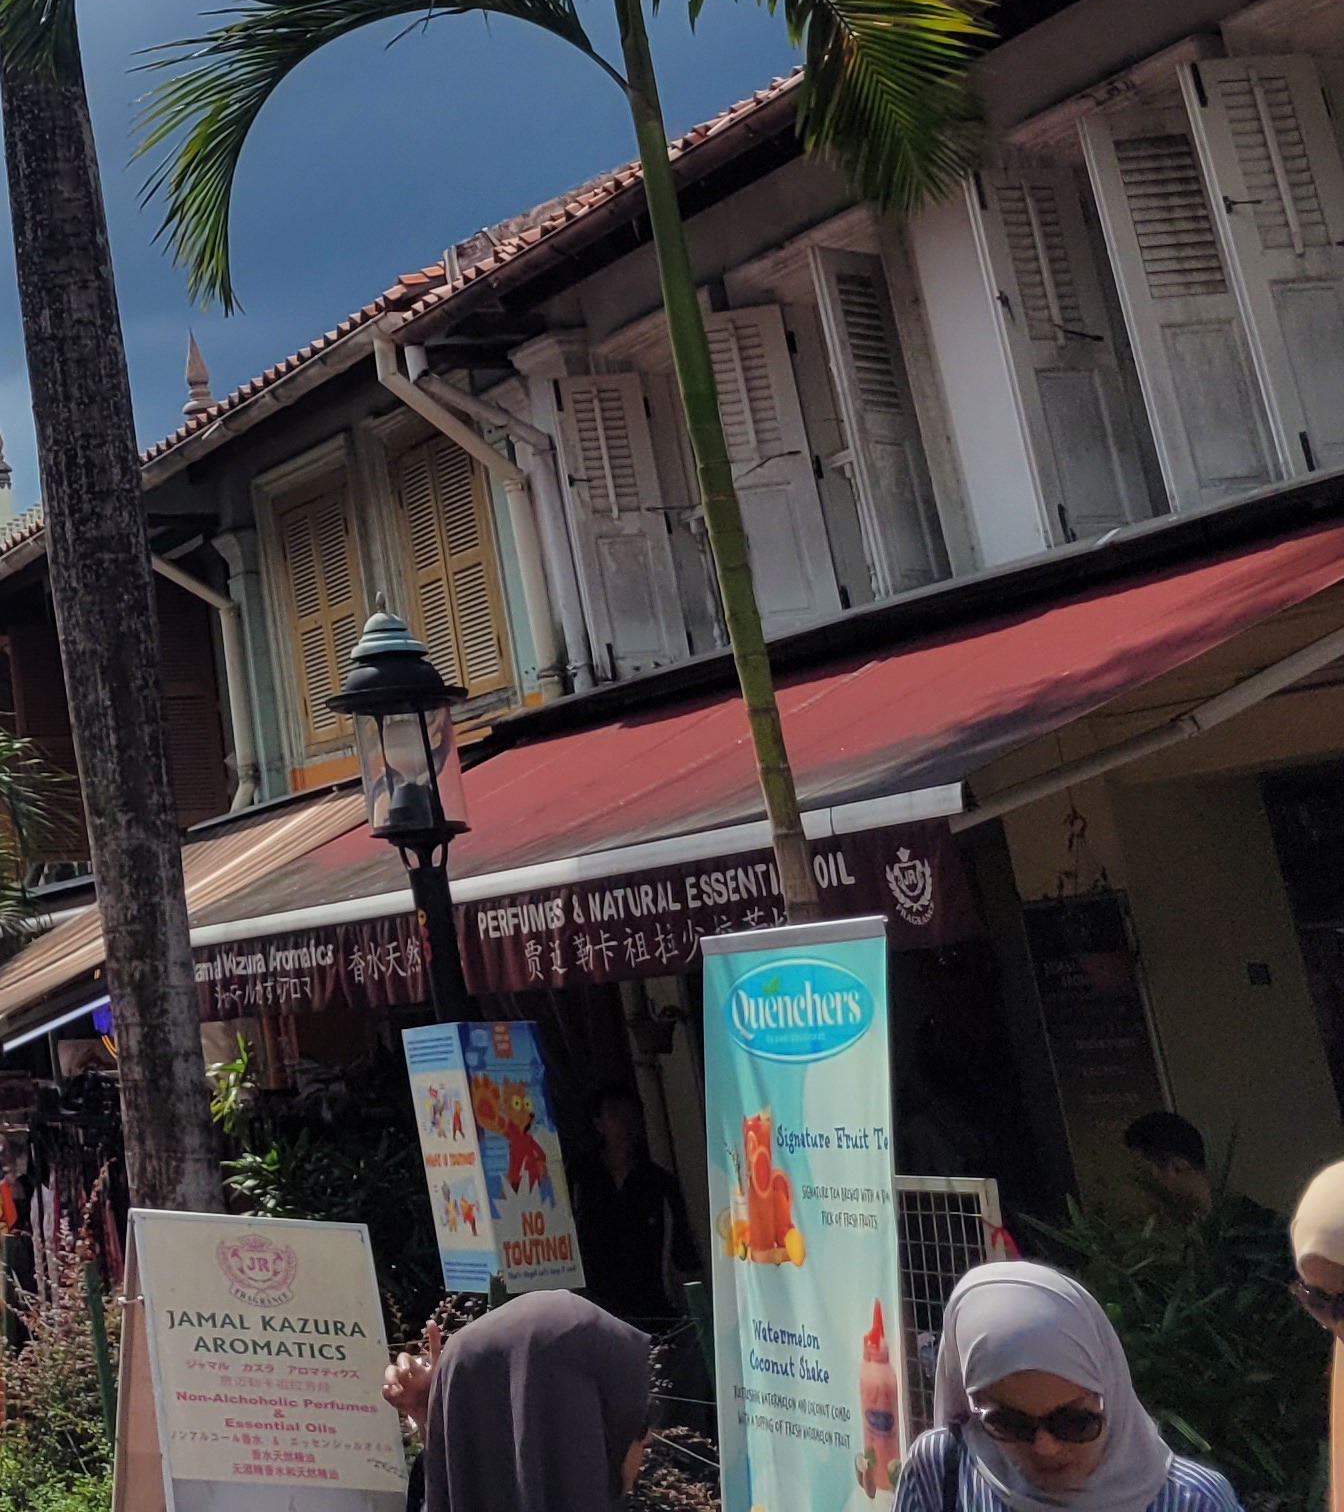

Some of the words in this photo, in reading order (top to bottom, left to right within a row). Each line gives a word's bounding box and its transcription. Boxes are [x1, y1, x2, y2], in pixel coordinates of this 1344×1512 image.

[477, 899, 564, 940] PERFUMES
[572, 894, 584, 925] &
[588, 881, 680, 923] NATURAL
[687, 863, 785, 906] ESSENTI
[813, 851, 855, 889] OIL
[732, 981, 862, 1040] Quenchers
[776, 1124, 831, 1154] Signature
[834, 1126, 869, 1150] Fruit
[873, 1128, 889, 1150] Te
[802, 1185, 829, 1201] SIGNATURE
[861, 1188, 873, 1204] WITH
[521, 1211, 545, 1236] NO
[246, 1256, 270, 1273] JR
[233, 1287, 290, 1306] FRAGRANCE
[167, 1310, 251, 1330] JAMAL
[261, 1315, 367, 1338] KAZURA
[752, 1319, 820, 1350] Watermelon
[194, 1336, 347, 1361] AROMATICS
[749, 1351, 795, 1377] Coconut
[799, 1355, 830, 1384] Shake
[176, 1391, 298, 1408] Non-Alchoholic
[304, 1398, 378, 1414] Perfumes
[274, 1409, 285, 1419] &
[761, 1392, 797, 1411] WATERMELON
[831, 1405, 851, 1422] COMBO
[225, 1418, 300, 1433] Essential
[305, 1422, 337, 1435] Oils
[775, 1420, 783, 1433] OF
[835, 1431, 850, 1449] FRUIT
